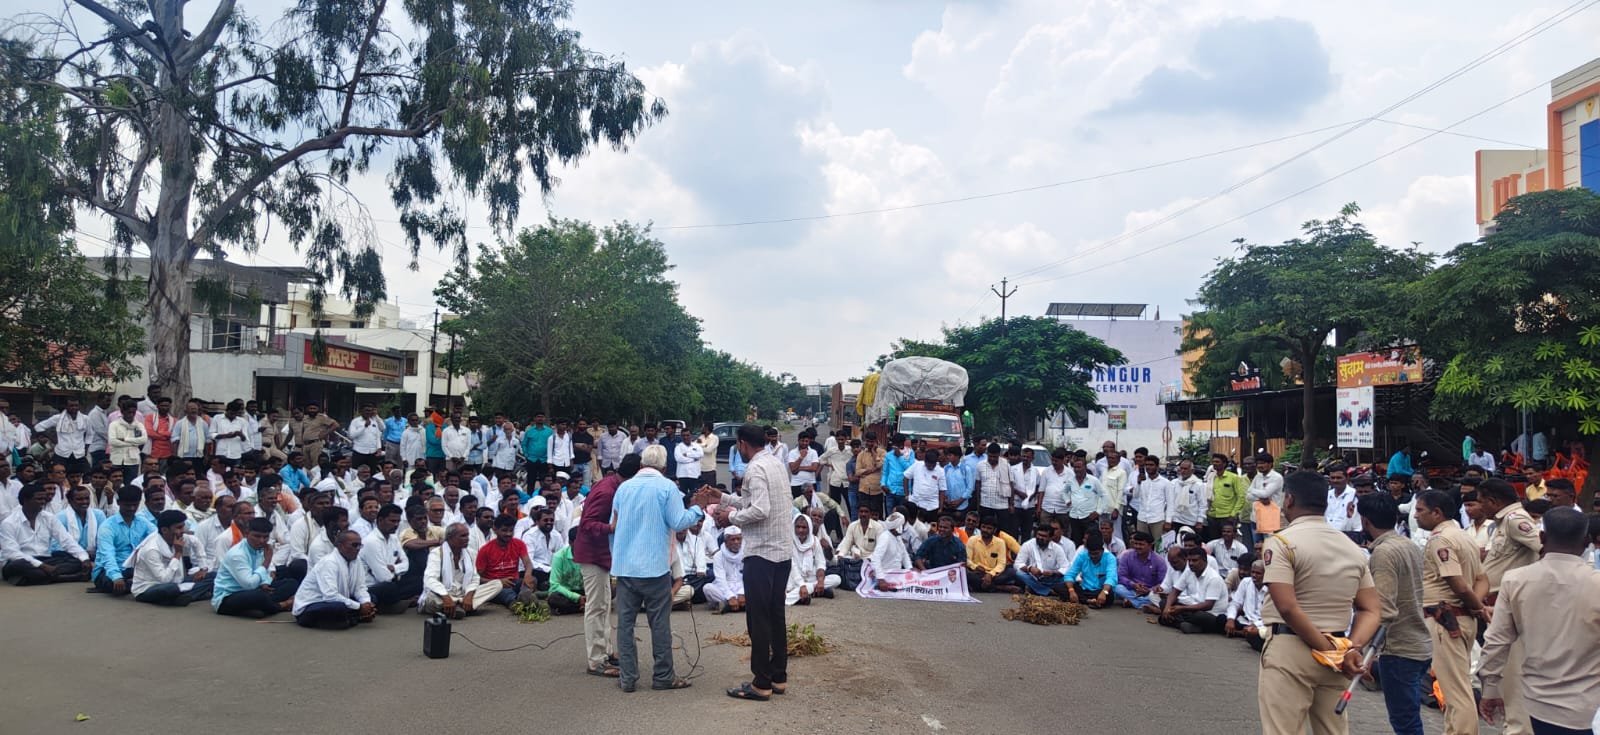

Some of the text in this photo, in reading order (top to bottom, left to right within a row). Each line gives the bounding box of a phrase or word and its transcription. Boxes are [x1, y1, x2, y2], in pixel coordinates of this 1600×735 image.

[328, 347, 359, 369] MRF
[1083, 366, 1151, 383] ANGUR
[1339, 360, 1365, 382] सुदाम
[1095, 384, 1140, 393] CEMENT
